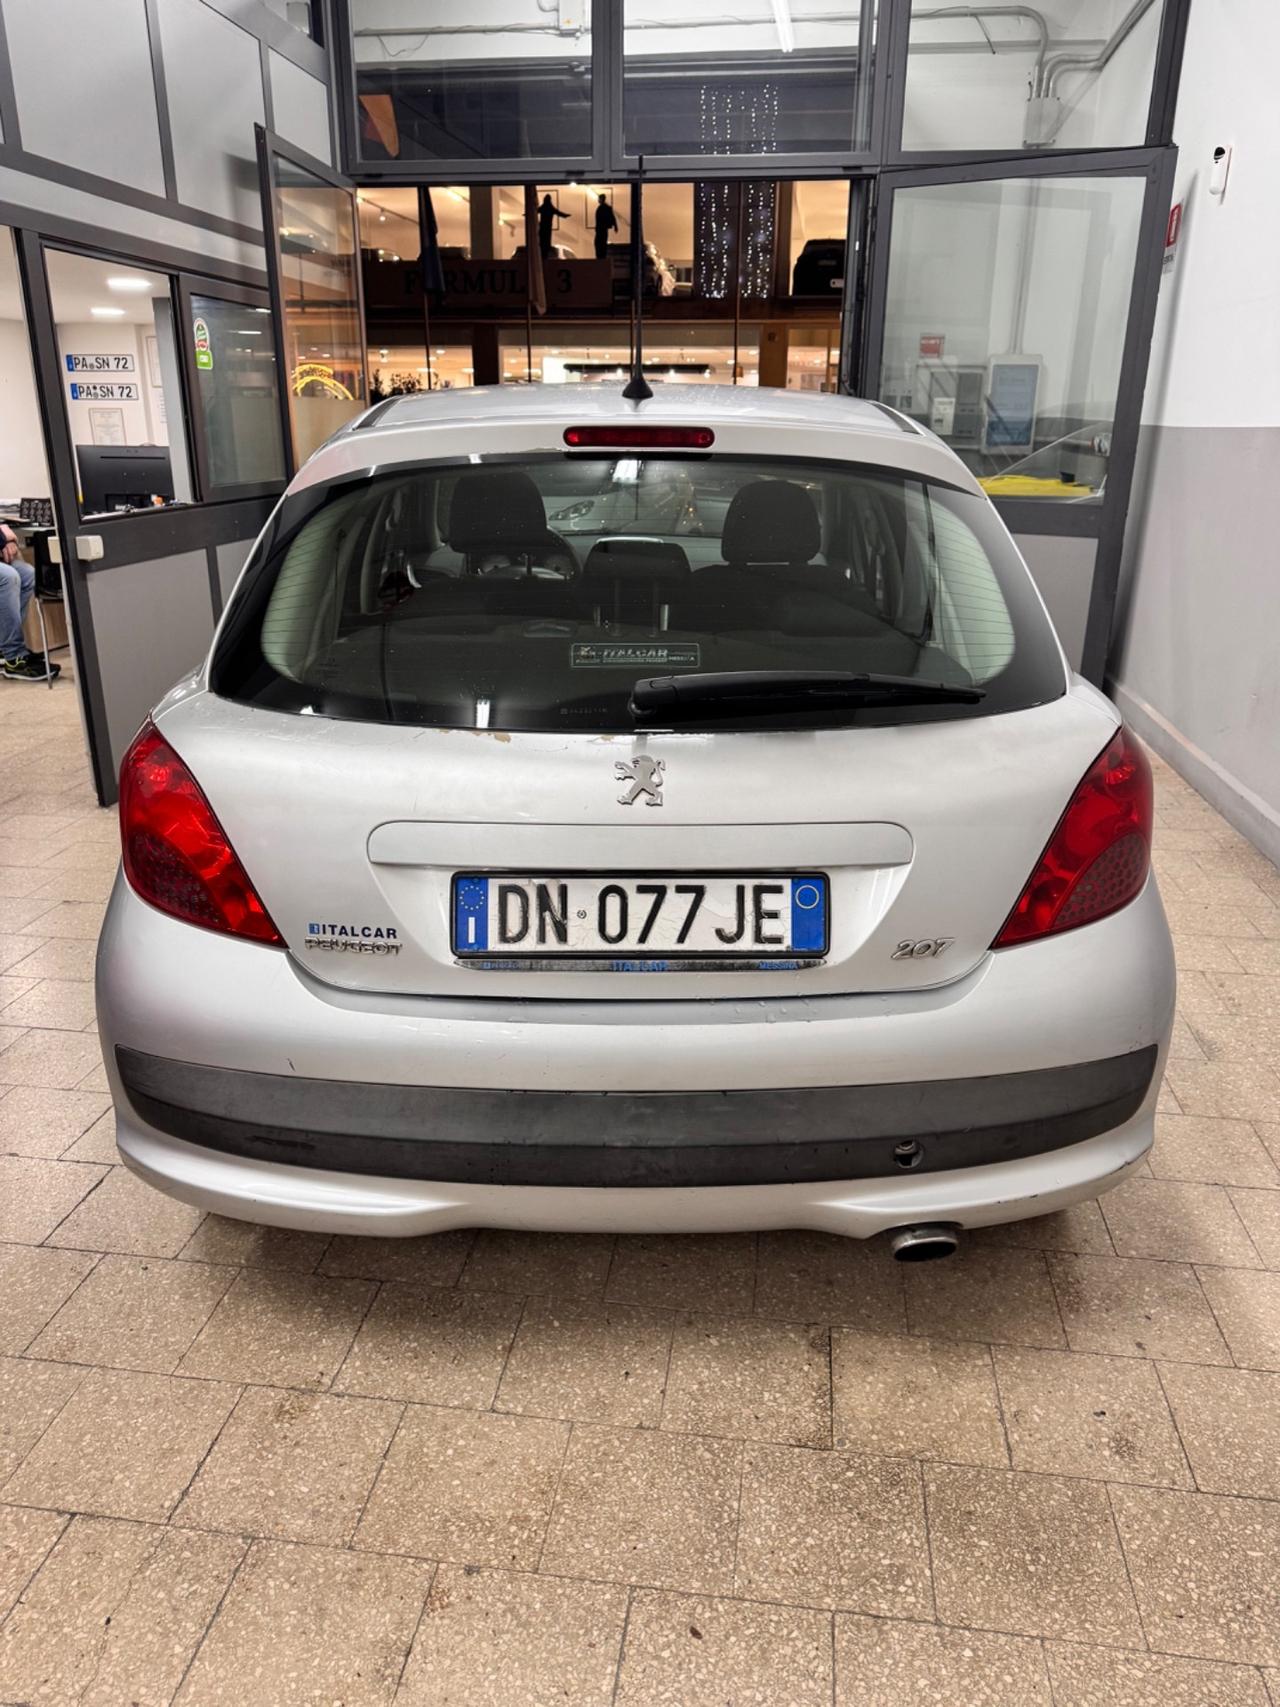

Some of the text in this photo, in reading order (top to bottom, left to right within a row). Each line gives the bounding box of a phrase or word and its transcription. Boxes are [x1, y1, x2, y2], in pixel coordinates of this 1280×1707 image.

[403, 268, 573, 295] FRMUL 3
[73, 356, 129, 369] PA SN 72
[78, 385, 133, 398] PA SN 72
[498, 884, 568, 944] DN
[321, 923, 397, 939] ITALCAR
[304, 937, 402, 955] PEUGEOT
[890, 937, 956, 960] 207
